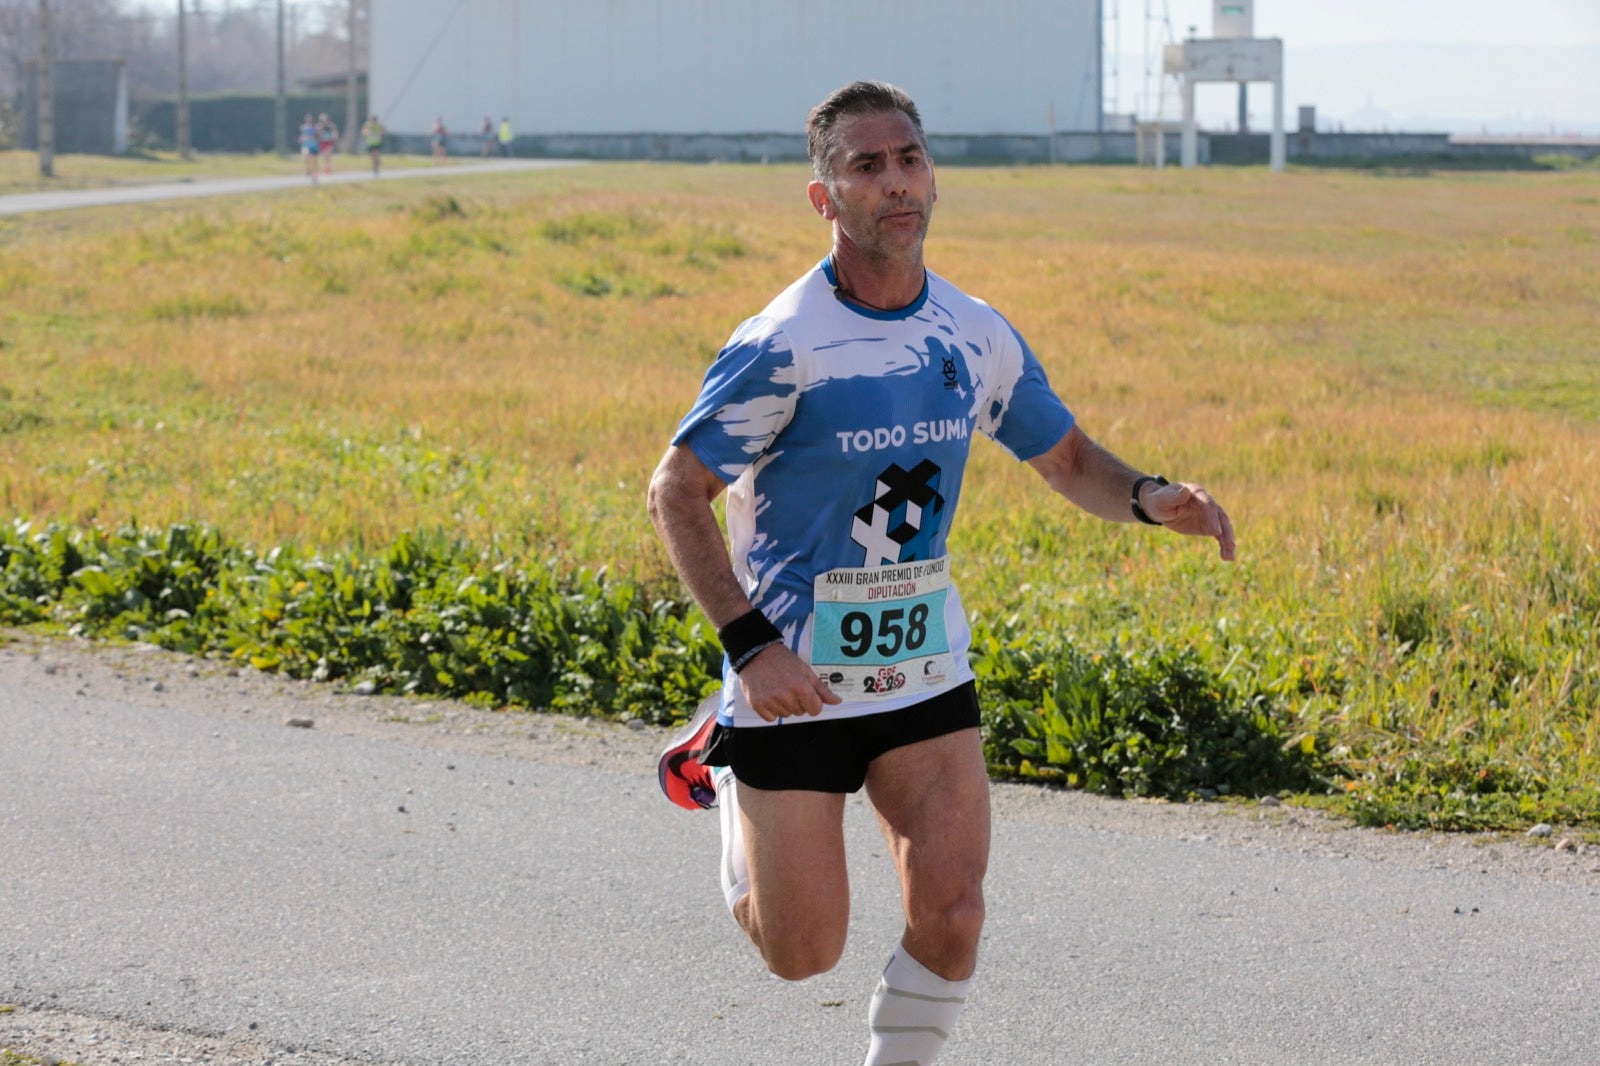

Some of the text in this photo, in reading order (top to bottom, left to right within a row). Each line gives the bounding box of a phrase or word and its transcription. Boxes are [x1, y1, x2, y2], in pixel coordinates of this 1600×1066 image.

[836, 417, 968, 453] TODO SUMA
[826, 573, 853, 585] XXXIII
[856, 571, 880, 585] GRAN
[882, 567, 912, 584] PREMIO
[913, 565, 923, 579] DE
[868, 583, 916, 600] DIPUTACIÓN
[840, 603, 929, 658] 958
